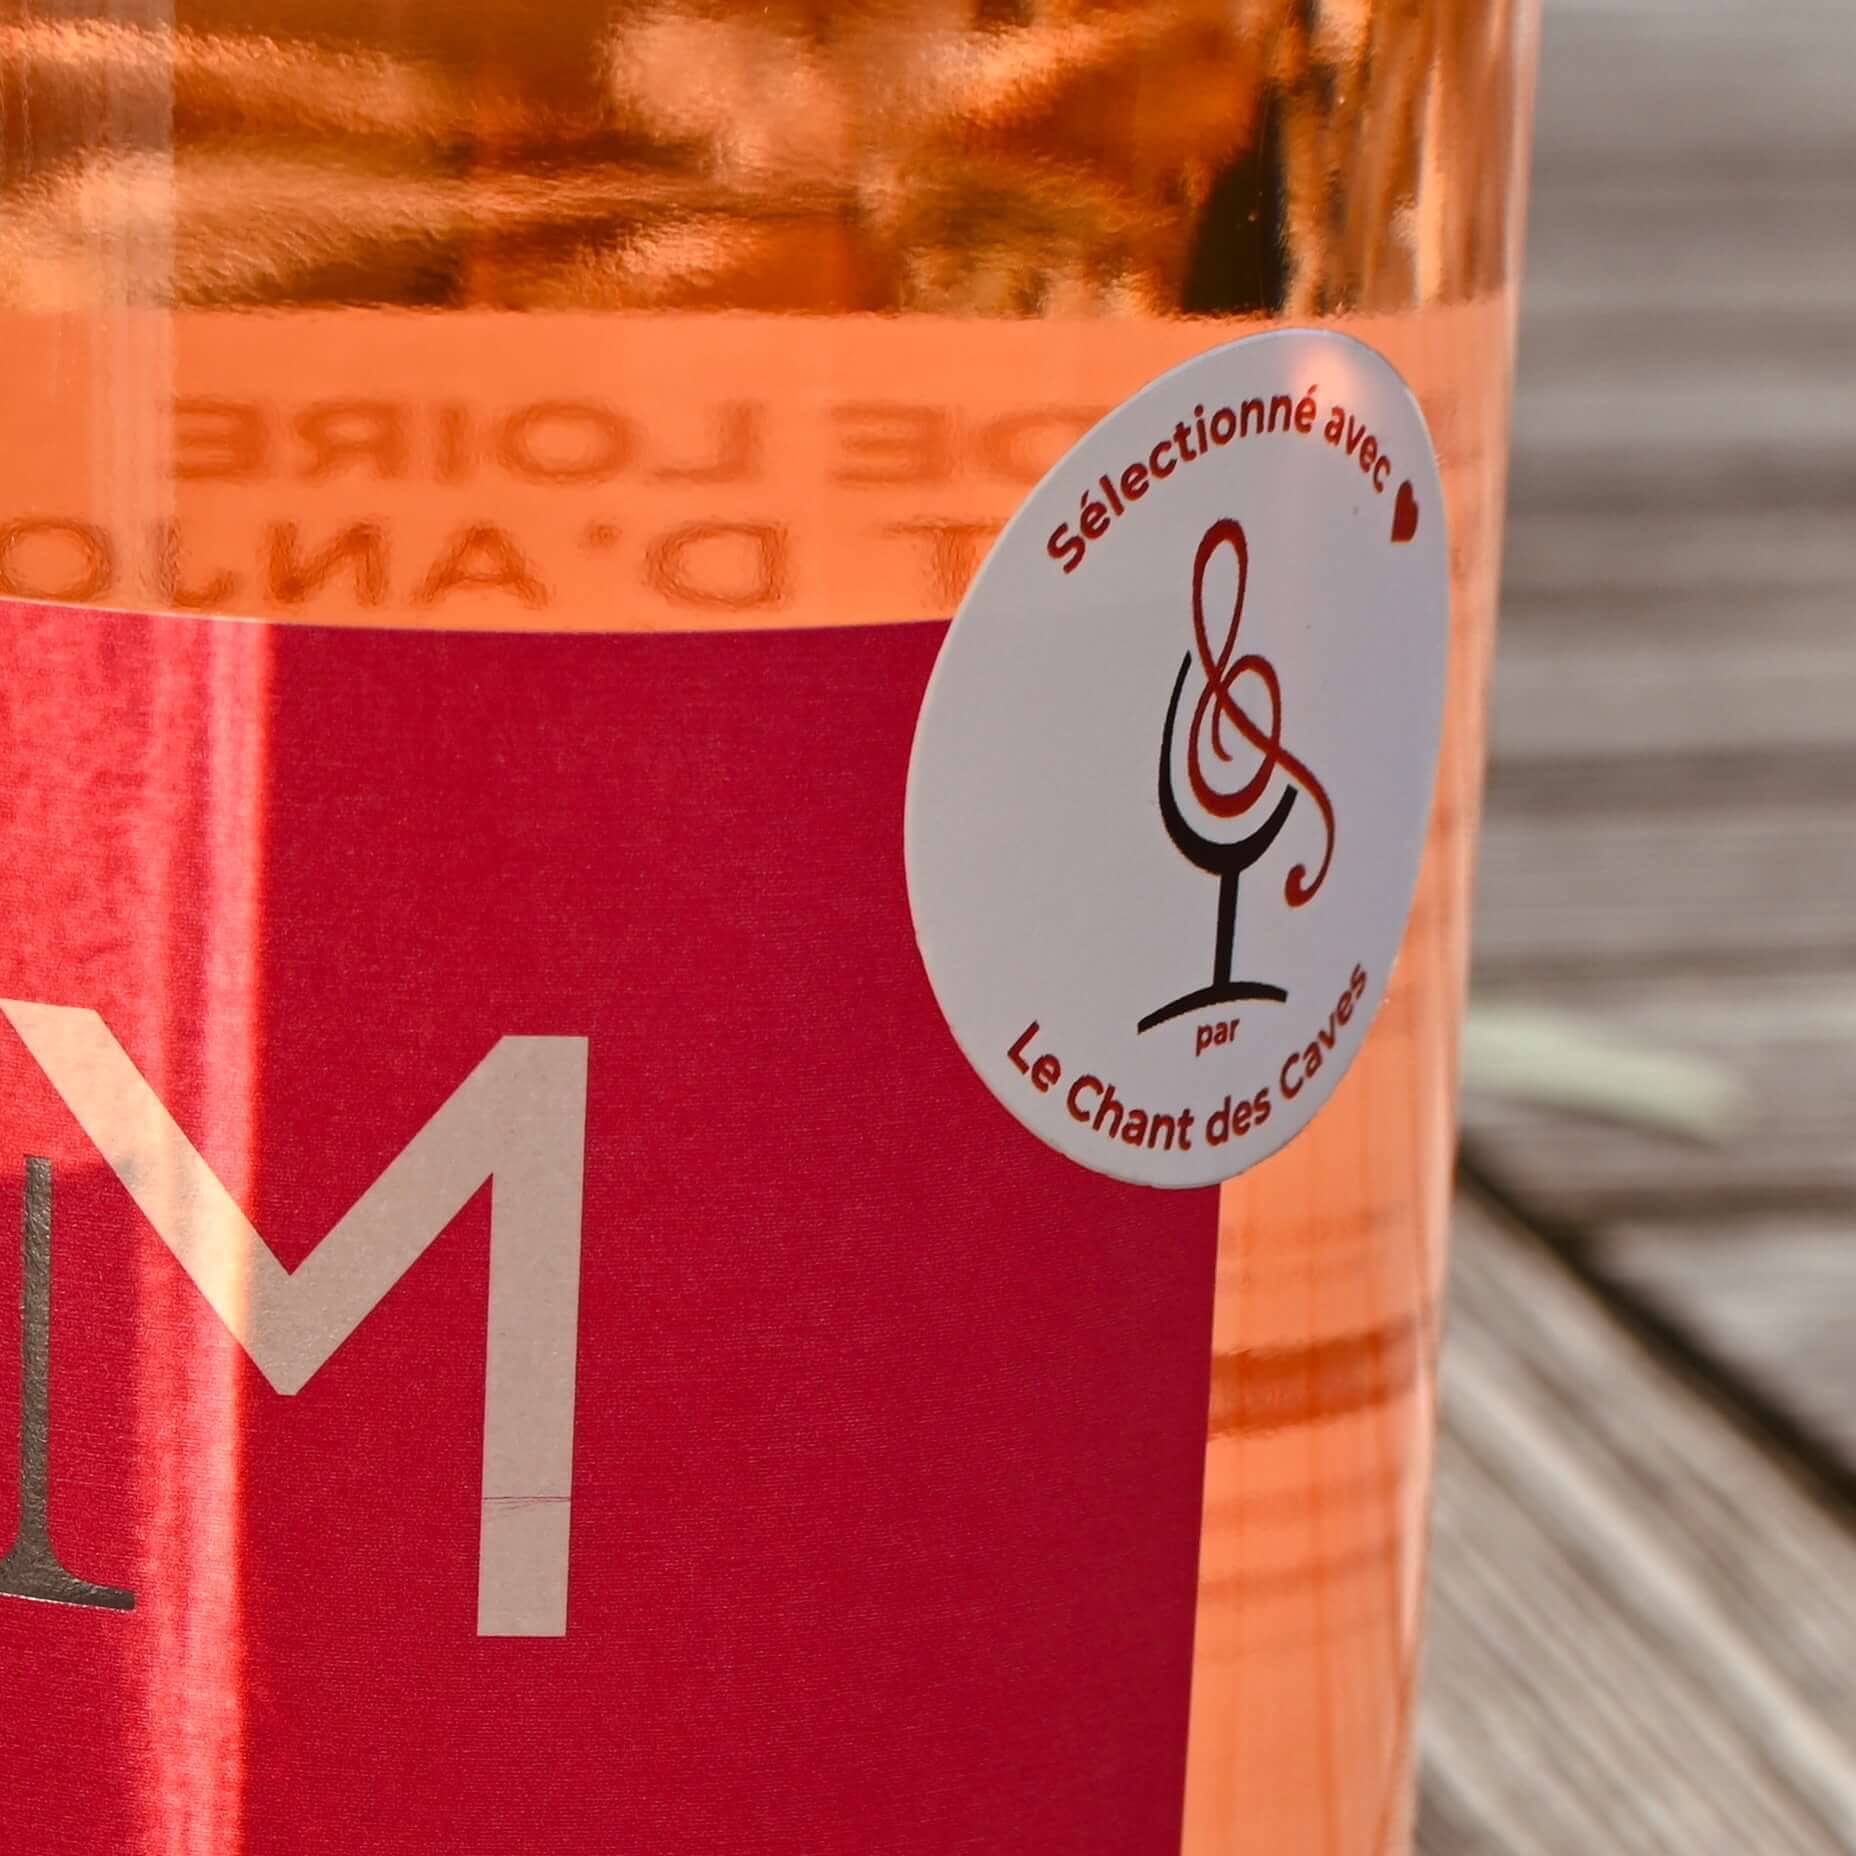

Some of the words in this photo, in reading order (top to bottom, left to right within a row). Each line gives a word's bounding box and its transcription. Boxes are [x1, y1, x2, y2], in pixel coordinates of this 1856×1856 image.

[1046, 383, 1318, 575] Sélectionné
[1323, 402, 1392, 495] avec
[1006, 1020, 1061, 1094] Le
[1066, 1068, 1193, 1152] Chant
[1205, 1082, 1273, 1148] des
[1279, 961, 1369, 1097] Caves
[1194, 1017, 1241, 1057] par
